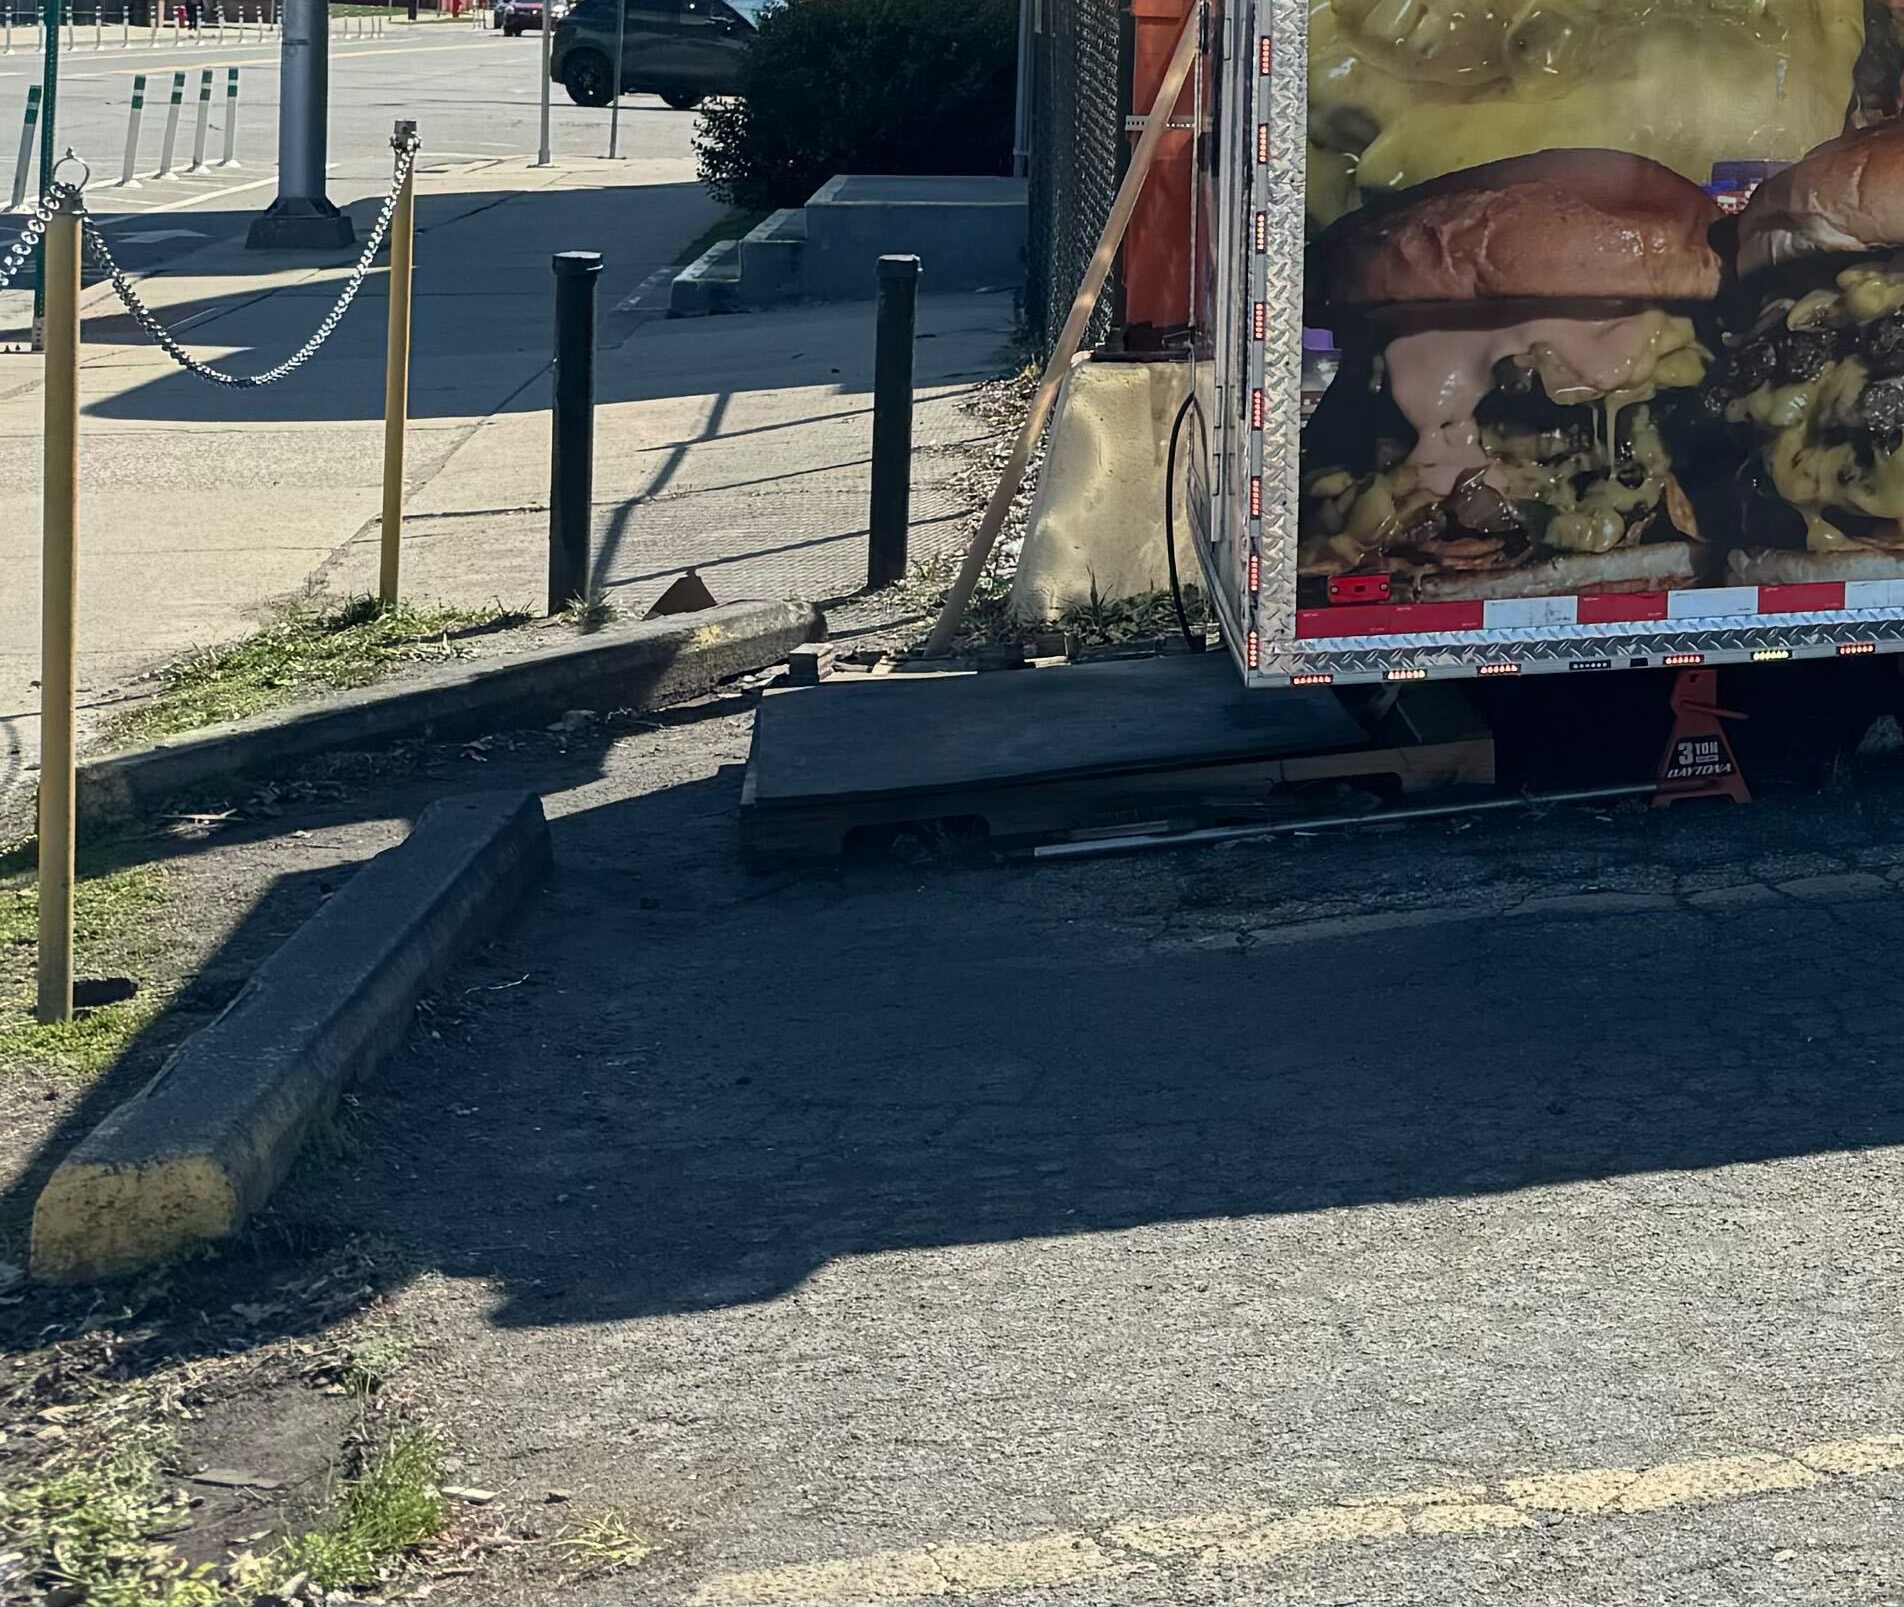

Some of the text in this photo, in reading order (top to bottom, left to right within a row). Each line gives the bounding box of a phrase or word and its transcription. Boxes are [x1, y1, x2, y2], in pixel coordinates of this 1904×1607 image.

[1678, 742, 1693, 764] 3
[1695, 742, 1718, 754] TON
[1667, 763, 1731, 778] DAYTONA
